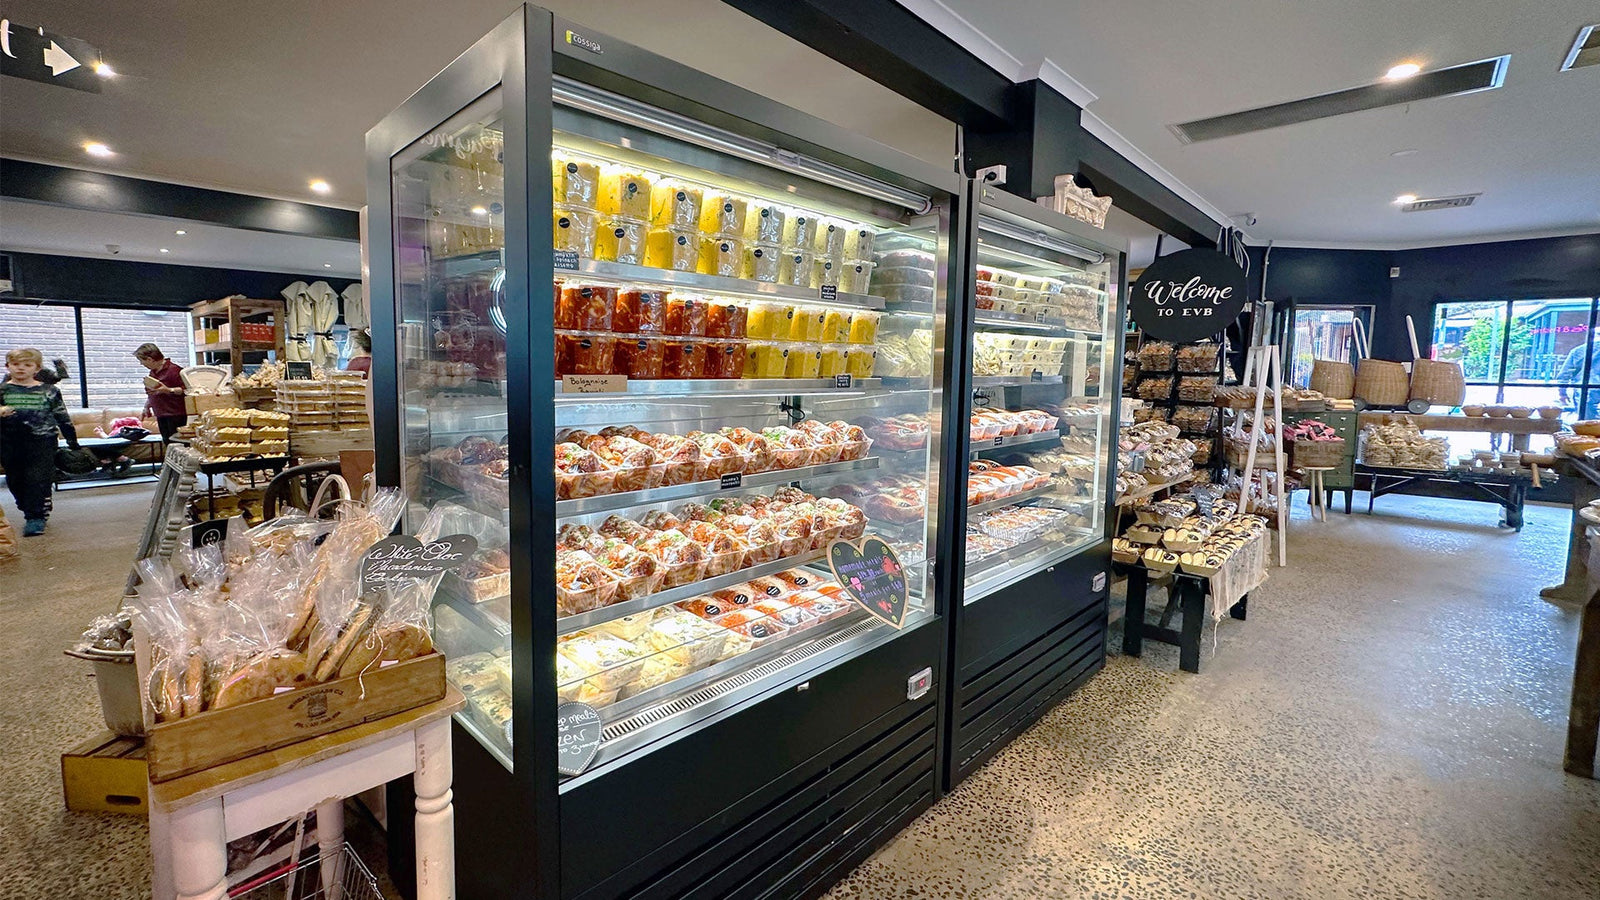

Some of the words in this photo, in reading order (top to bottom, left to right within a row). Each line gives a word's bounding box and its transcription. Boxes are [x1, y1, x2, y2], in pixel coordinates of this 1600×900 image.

[1144, 276, 1233, 306] Welcome
[1157, 308, 1174, 317] TO
[1182, 307, 1213, 317] EVB
[569, 376, 609, 387] Bolognaise
[570, 744, 582, 755] 3
